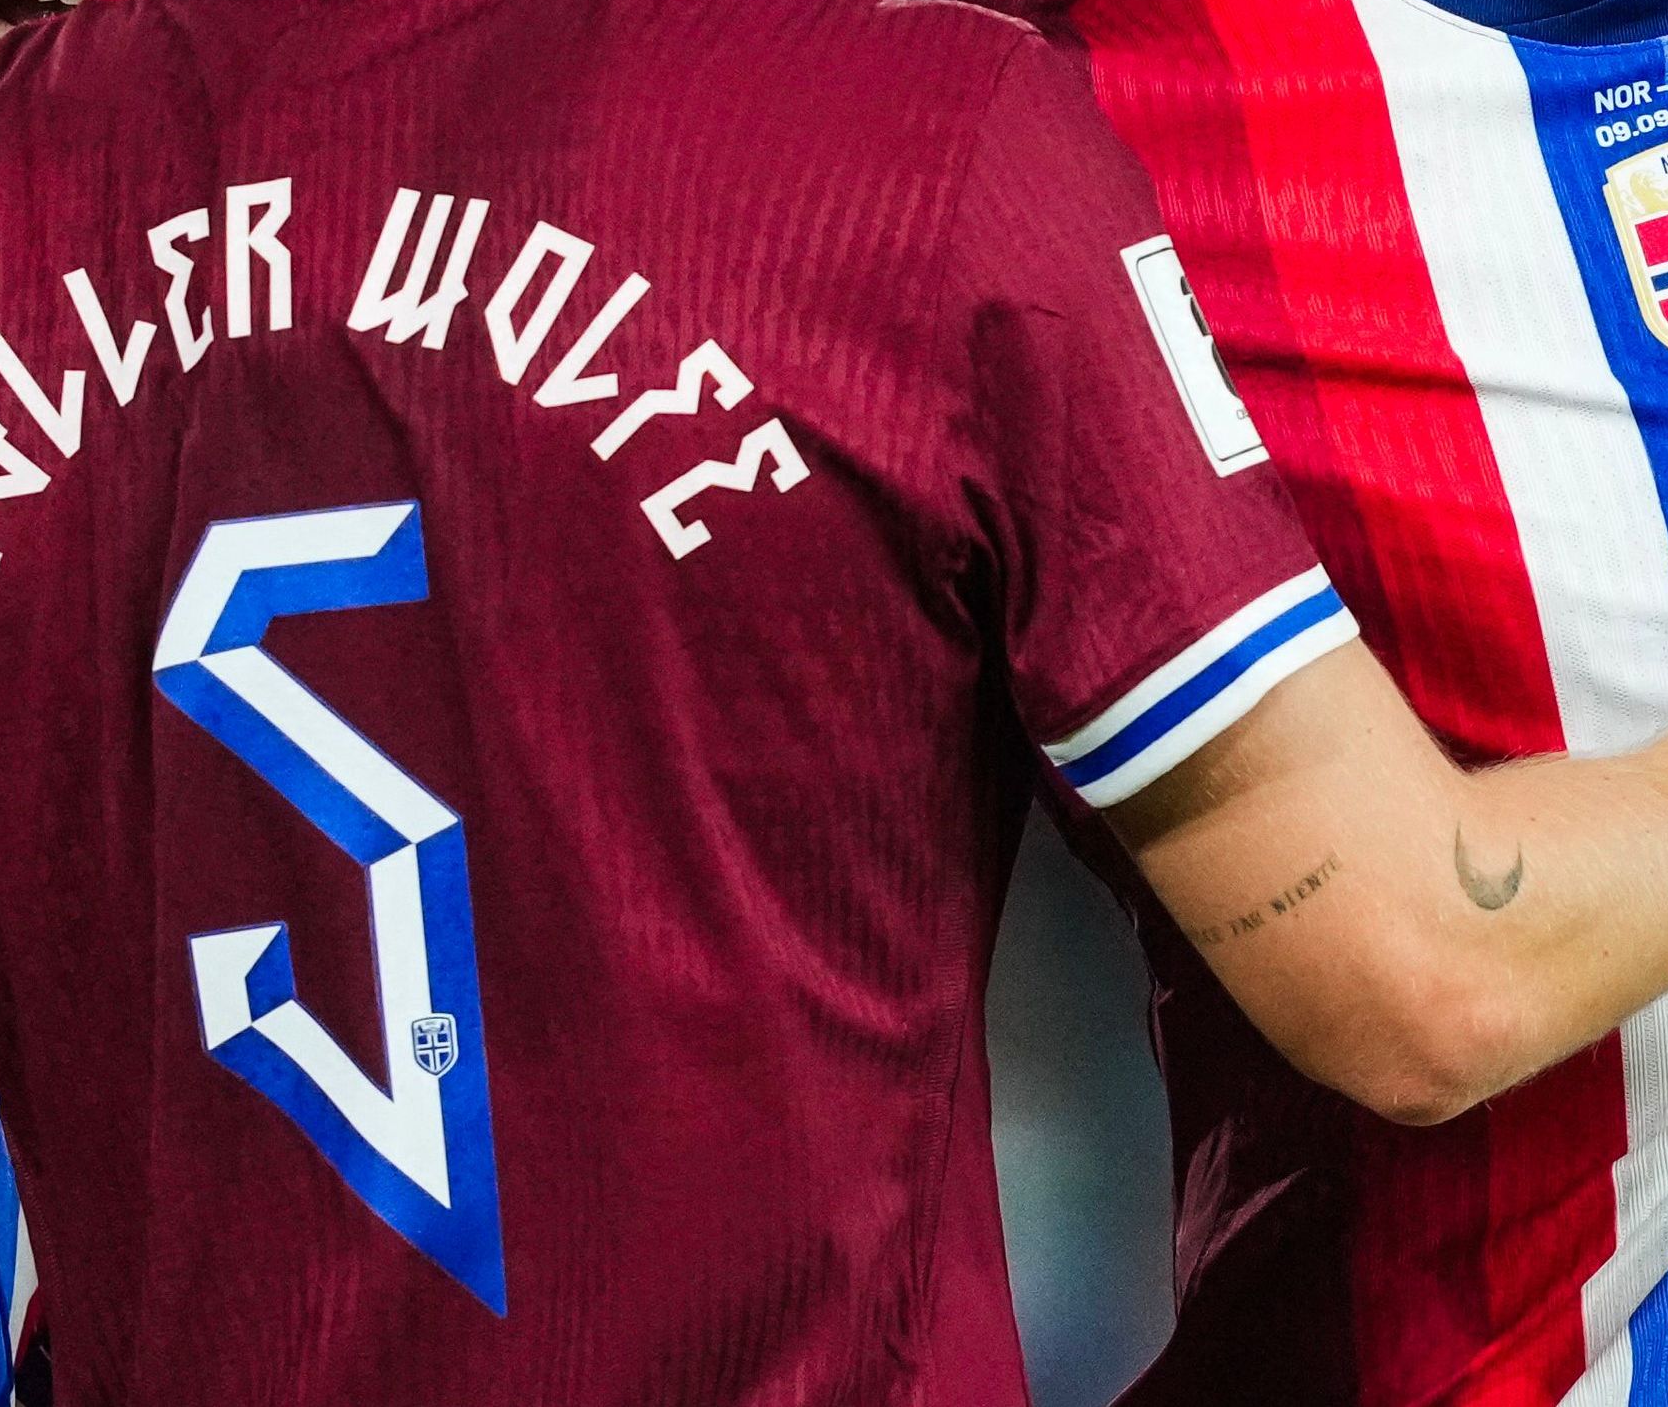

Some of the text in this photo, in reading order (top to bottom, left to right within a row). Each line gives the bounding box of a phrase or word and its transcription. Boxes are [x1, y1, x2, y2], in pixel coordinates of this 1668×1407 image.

[1594, 80, 1652, 114] NOR
[346, 186, 811, 561] WOLFE
[152, 499, 508, 1319] 5
